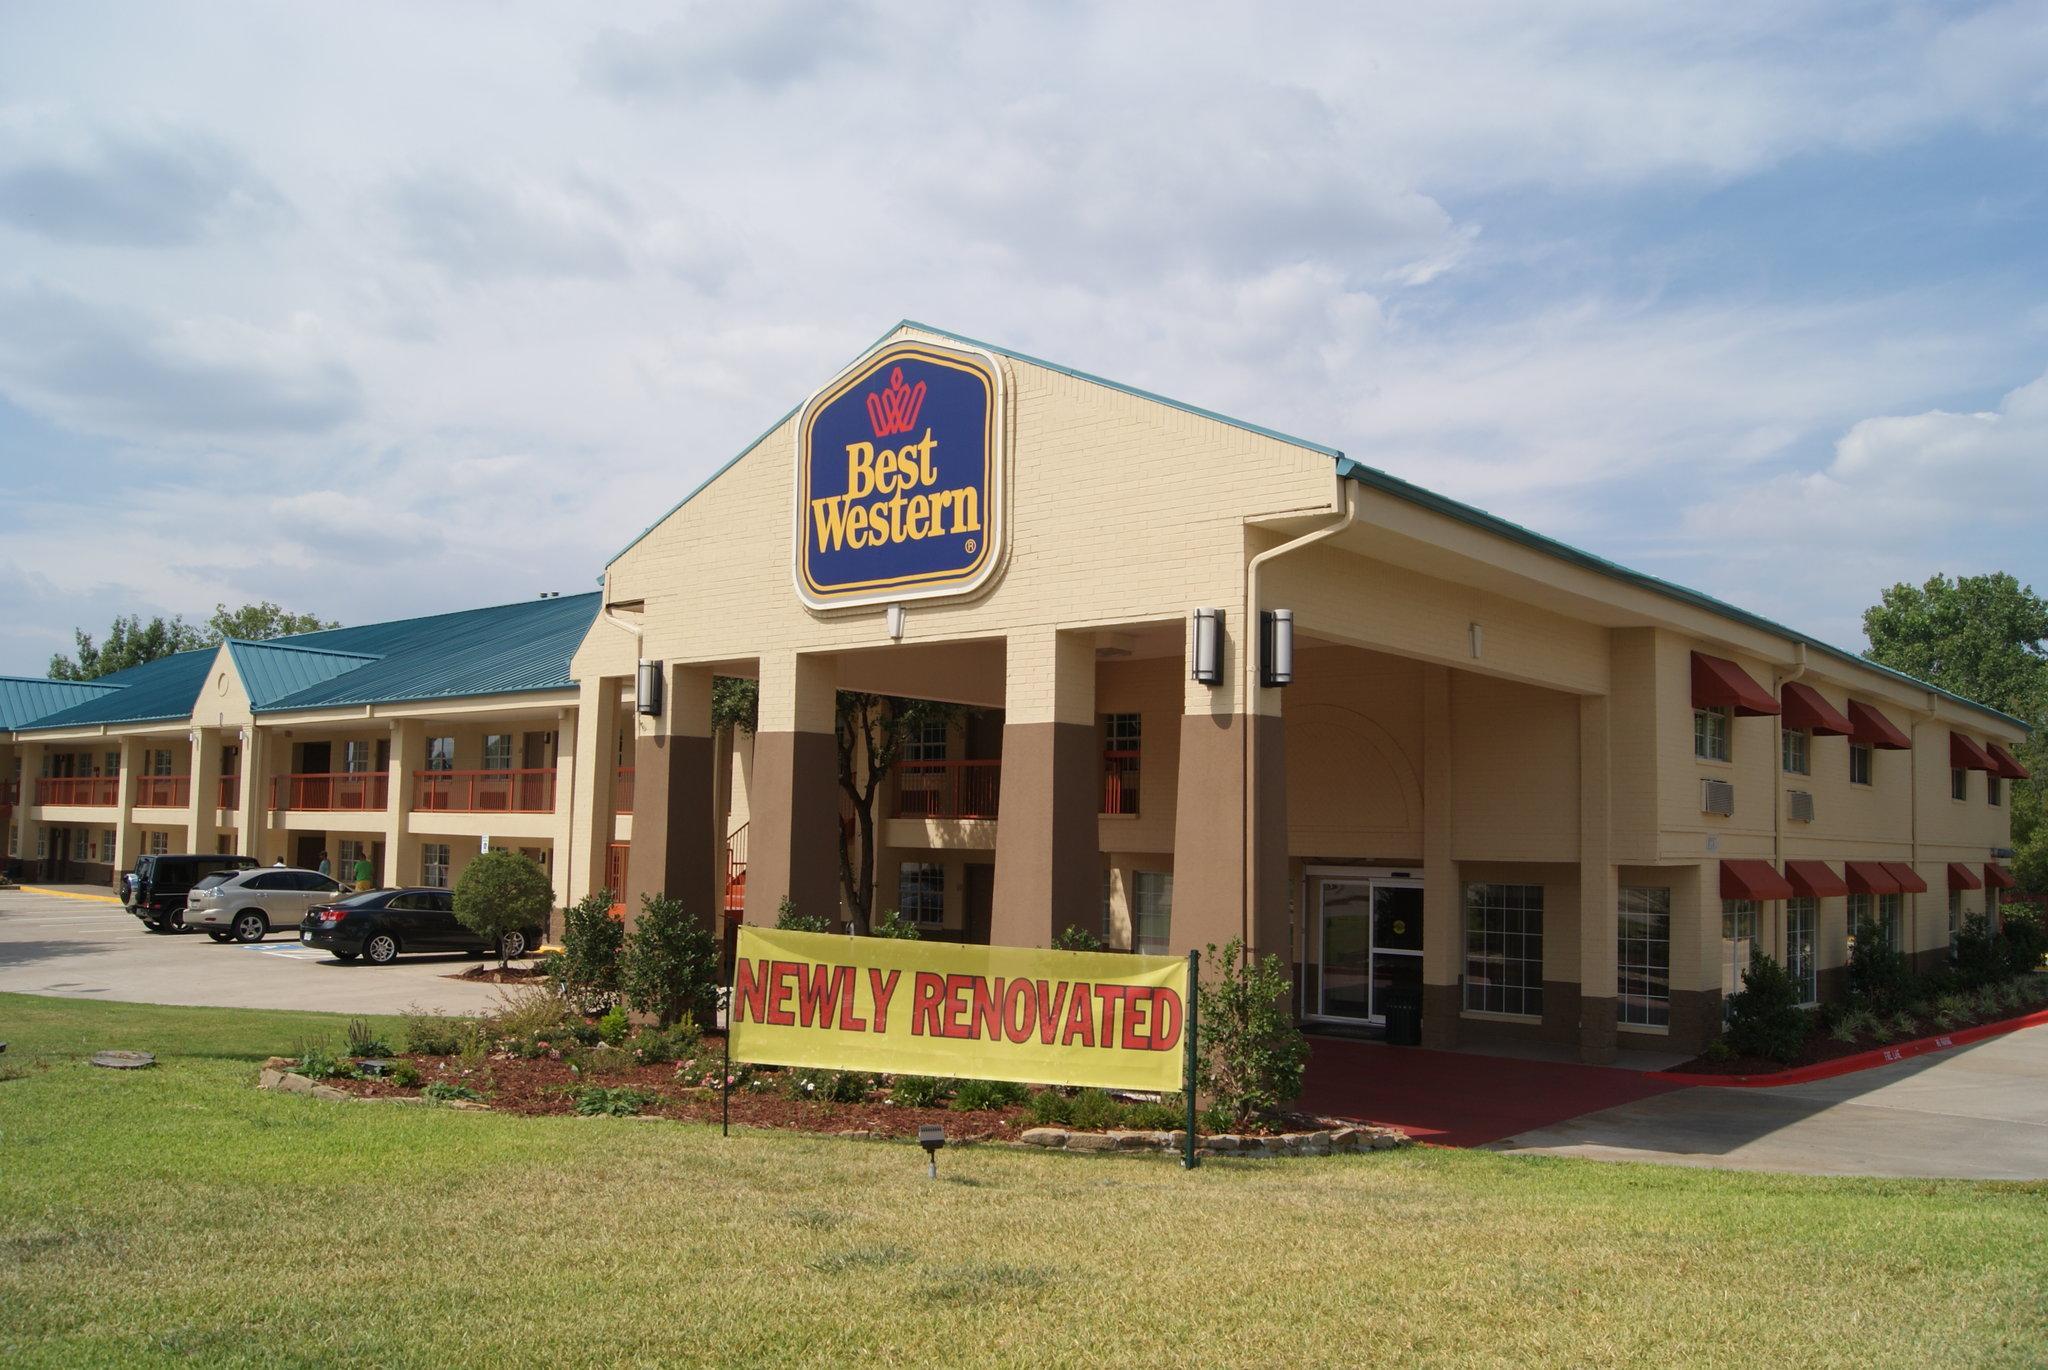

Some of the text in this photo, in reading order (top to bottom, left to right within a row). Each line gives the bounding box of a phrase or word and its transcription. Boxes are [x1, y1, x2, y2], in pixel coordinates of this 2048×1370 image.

[846, 427, 938, 500] Best
[811, 474, 981, 554] Western
[733, 957, 1183, 1052] NEWLY RENOVATED
